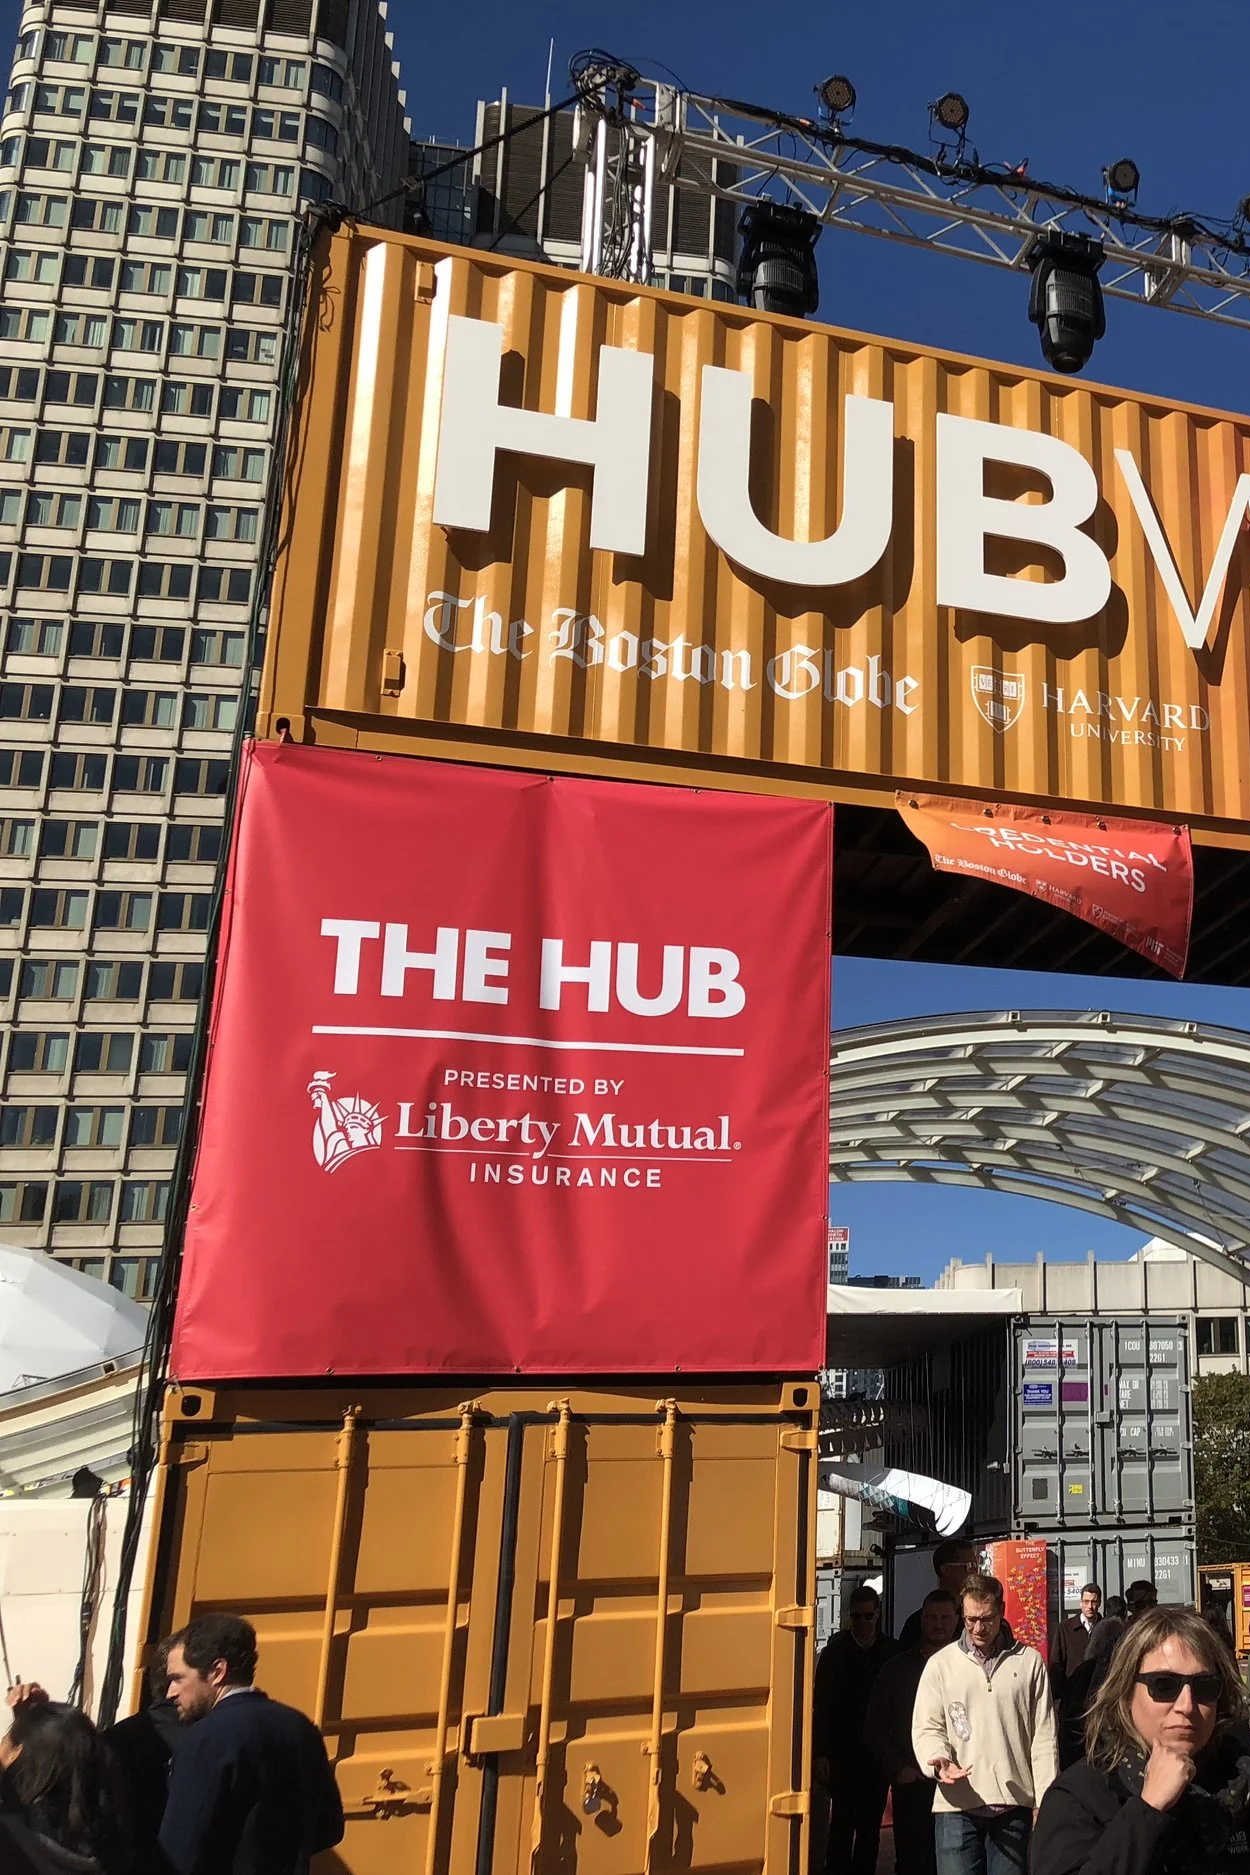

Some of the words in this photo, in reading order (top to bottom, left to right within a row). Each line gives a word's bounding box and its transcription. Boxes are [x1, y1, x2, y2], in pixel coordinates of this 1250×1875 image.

[424, 591, 534, 659] The
[547, 608, 757, 691] Boston
[767, 645, 919, 715] Globe
[1041, 682, 1211, 731] HARVARD
[1070, 723, 1186, 751] UNIVERSITY
[934, 854, 955, 866] The
[957, 859, 997, 876] Boston
[998, 868, 1027, 885] Globe
[990, 837, 1146, 893] HOLDERS
[320, 918, 512, 1005] THE
[539, 938, 746, 1019] HUB
[444, 1069, 585, 1095] PRESENTED
[594, 1078, 625, 1096] BY
[394, 1101, 561, 1159] Liberty
[469, 1162, 662, 1188] INSURANCE
[1154, 1569, 1171, 1580] 22G1
